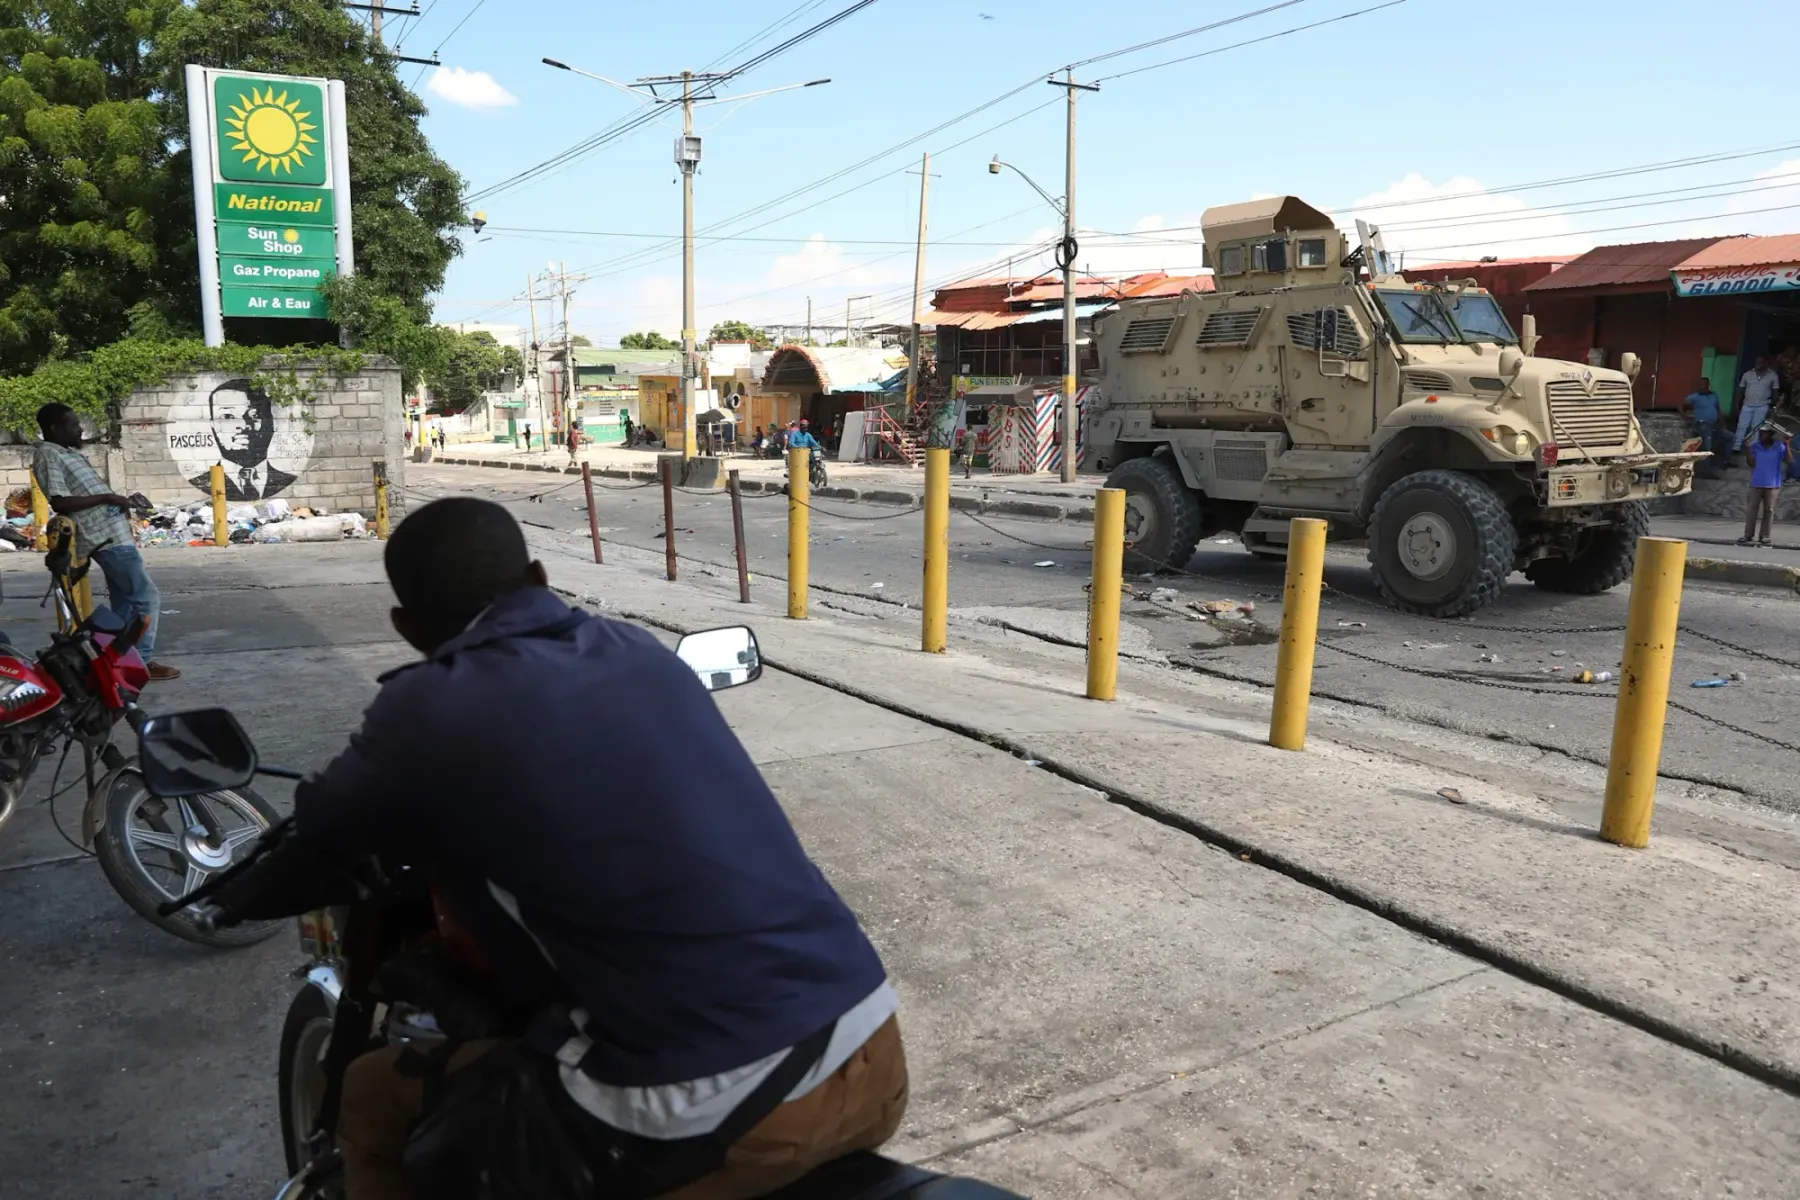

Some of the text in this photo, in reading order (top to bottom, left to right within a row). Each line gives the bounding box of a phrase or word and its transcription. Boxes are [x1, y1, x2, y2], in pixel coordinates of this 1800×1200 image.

[228, 194, 322, 212] National
[247, 227, 277, 240] Sun
[263, 240, 303, 255] Shop
[233, 264, 320, 278] Gaz Propane
[248, 297, 310, 309] Air & Eau
